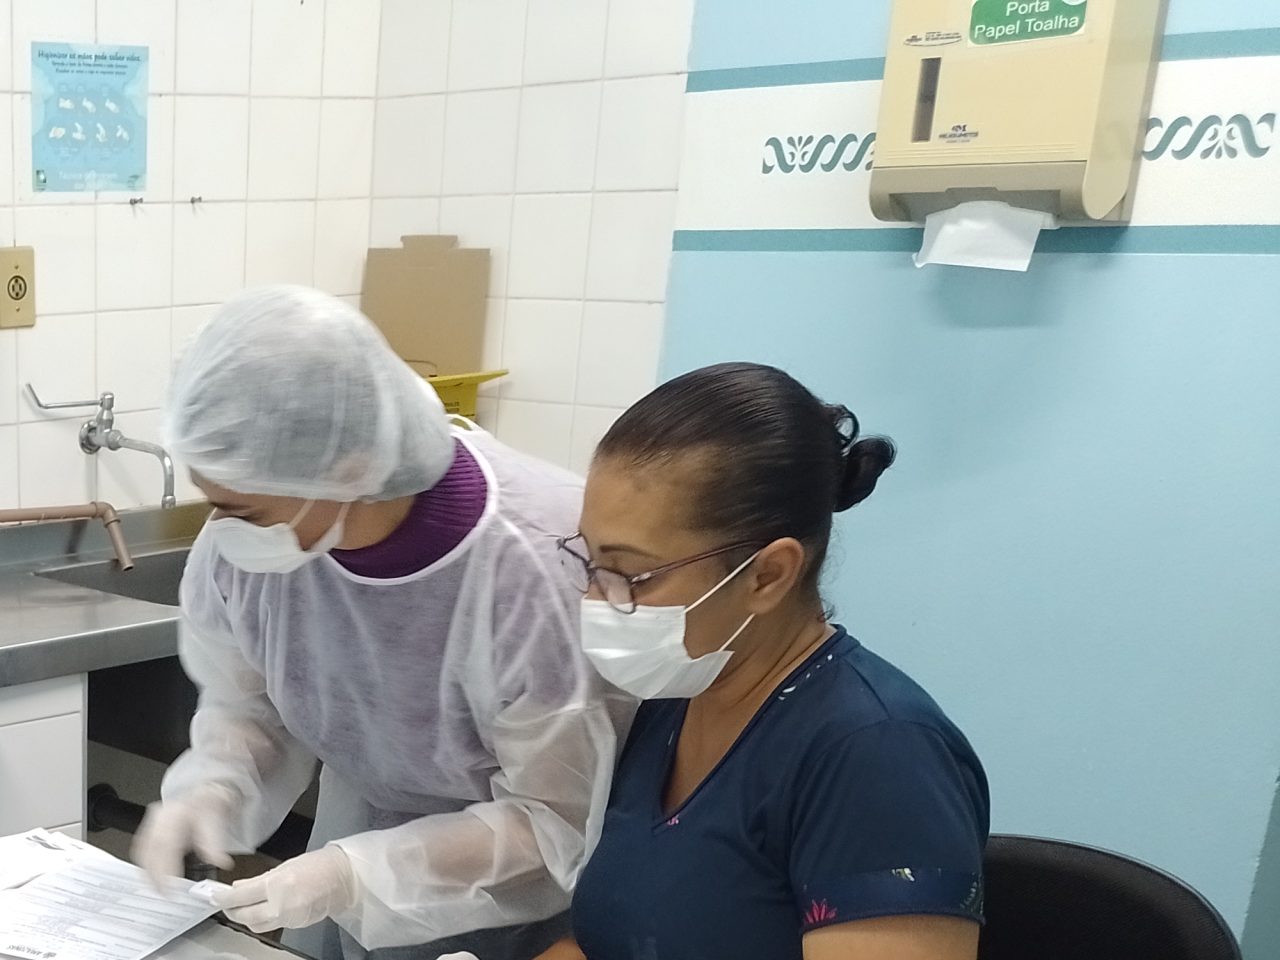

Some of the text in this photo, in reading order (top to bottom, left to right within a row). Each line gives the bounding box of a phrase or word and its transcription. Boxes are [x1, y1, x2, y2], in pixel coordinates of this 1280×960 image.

[1006, 0, 1050, 16] Porta
[974, 20, 1020, 39] Papel
[1025, 15, 1079, 32] Toalha
